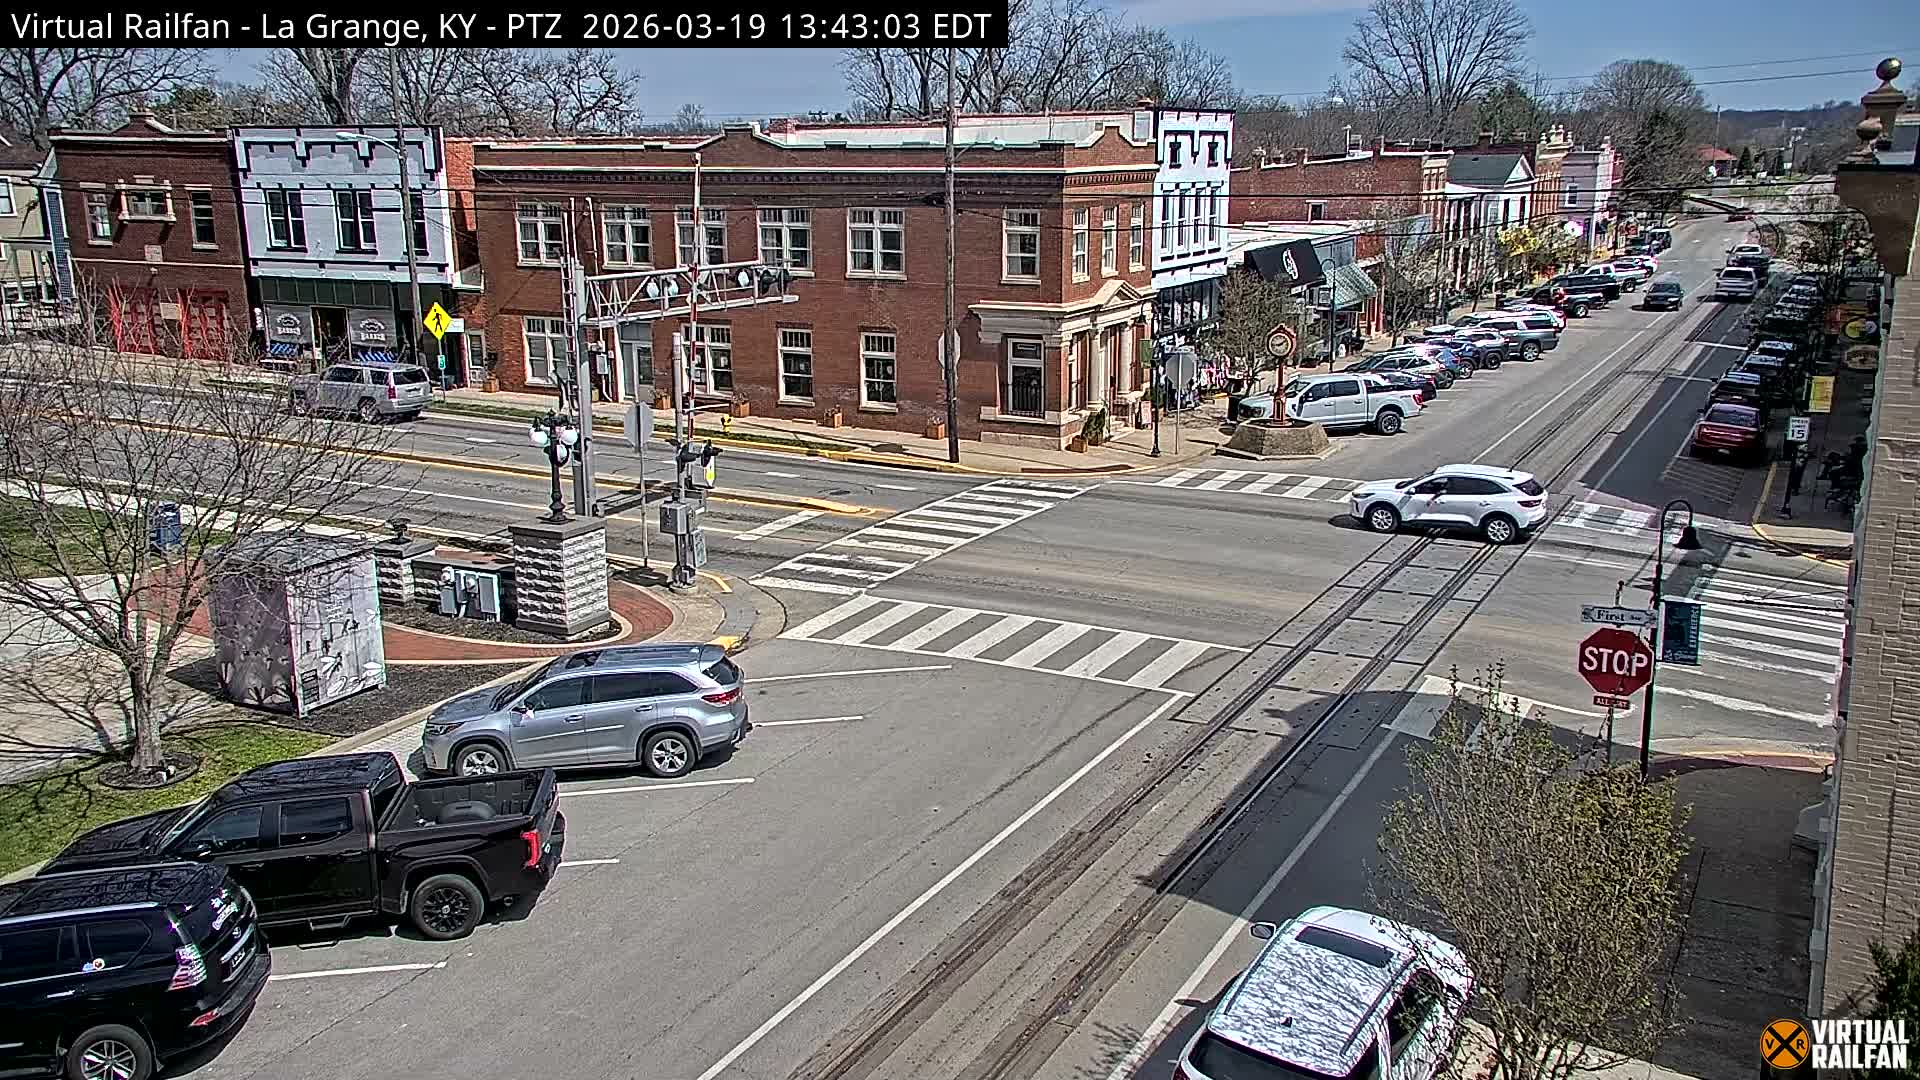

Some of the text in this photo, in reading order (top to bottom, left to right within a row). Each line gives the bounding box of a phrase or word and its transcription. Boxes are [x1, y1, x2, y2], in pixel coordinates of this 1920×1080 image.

[1791, 429, 1805, 439] 15
[1596, 609, 1625, 622] First
[1582, 646, 1648, 677] STOP
[1596, 697, 1610, 706] ALL
